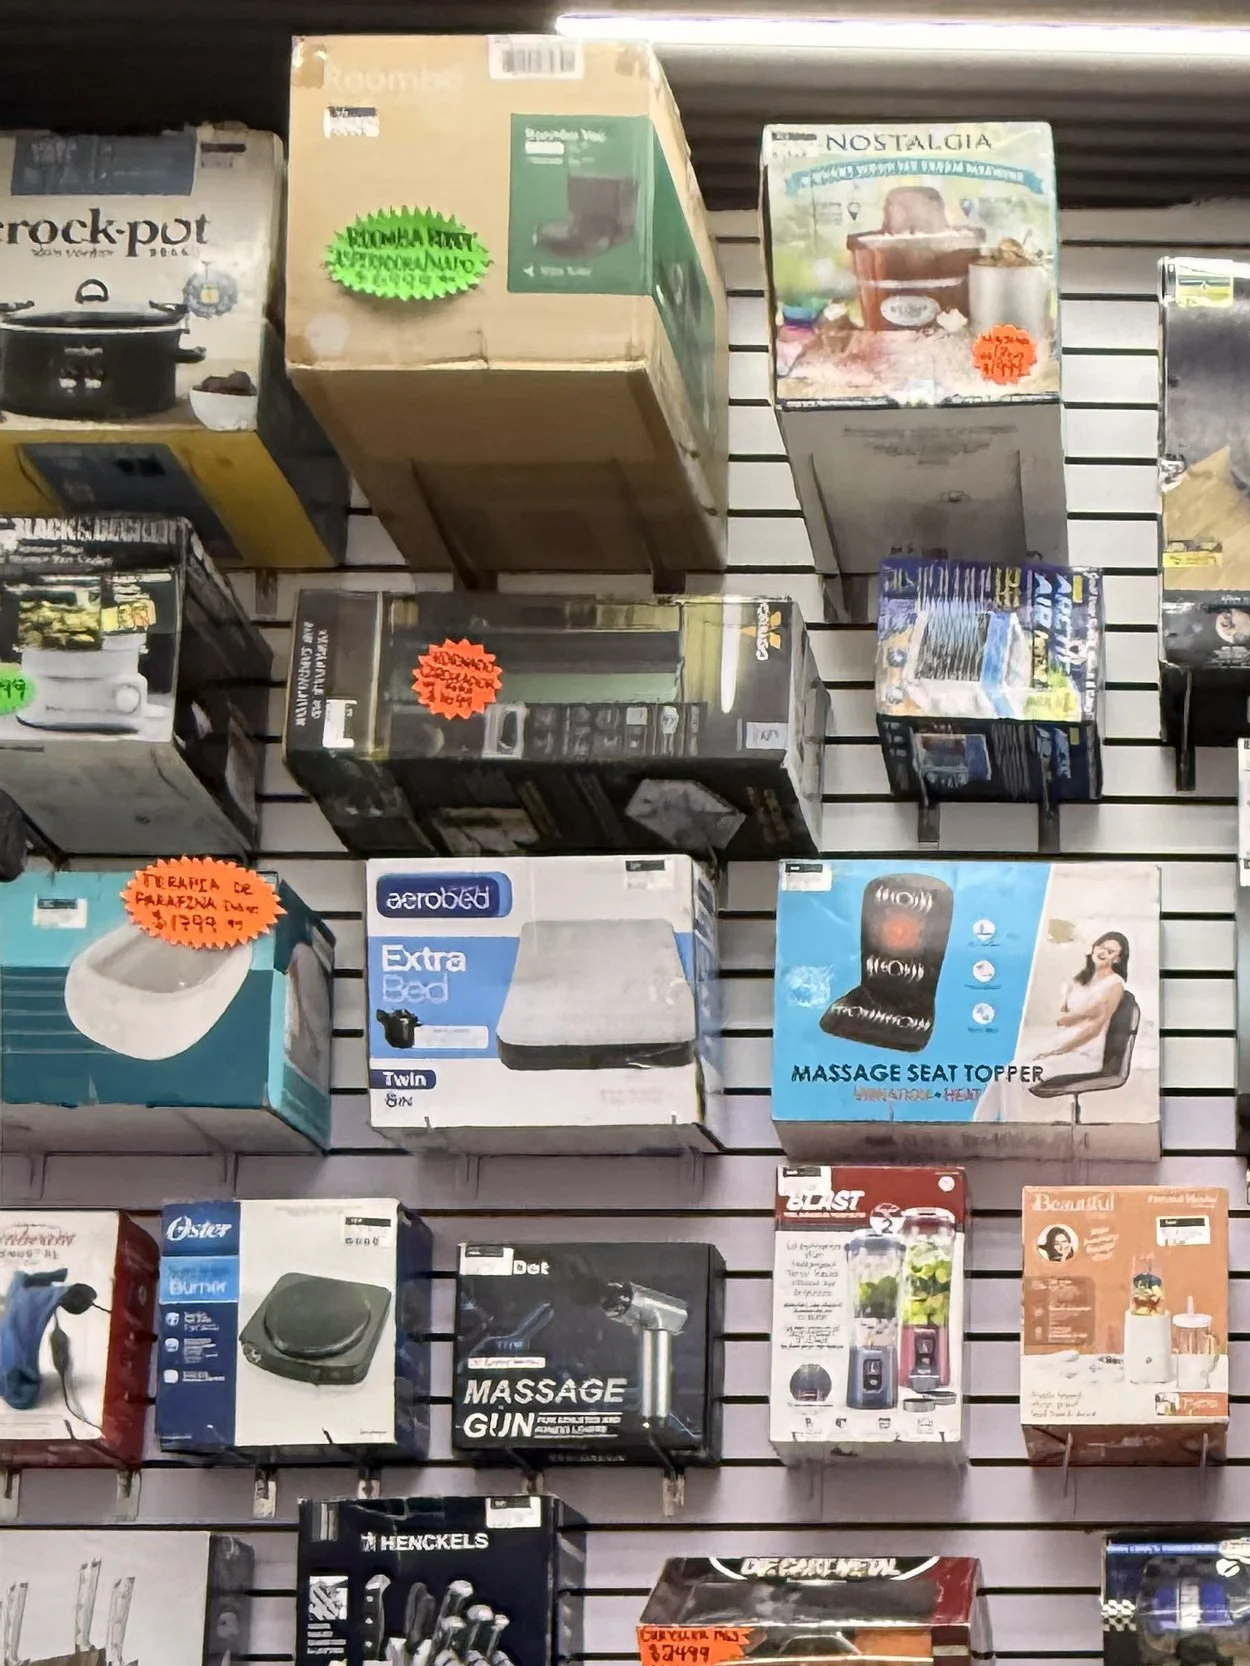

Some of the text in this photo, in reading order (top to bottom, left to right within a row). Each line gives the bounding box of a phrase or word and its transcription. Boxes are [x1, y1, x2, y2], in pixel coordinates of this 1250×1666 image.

[826, 132, 992, 152] NOSTALGIA
[0, 207, 211, 257] rock-pot
[1034, 571, 1053, 629] AIR
[386, 884, 490, 910] aerobed
[382, 944, 466, 973] Extra
[382, 973, 448, 1004] Bed
[382, 1071, 427, 1088] Twin
[791, 1064, 1043, 1083] MASSAGE SEAT TOPPER
[166, 1216, 233, 1241] Oster
[168, 1277, 226, 1296] Burner
[463, 1377, 628, 1404] MASSAGE
[463, 1412, 536, 1438] GUN
[380, 1532, 489, 1550] HENCKELS
